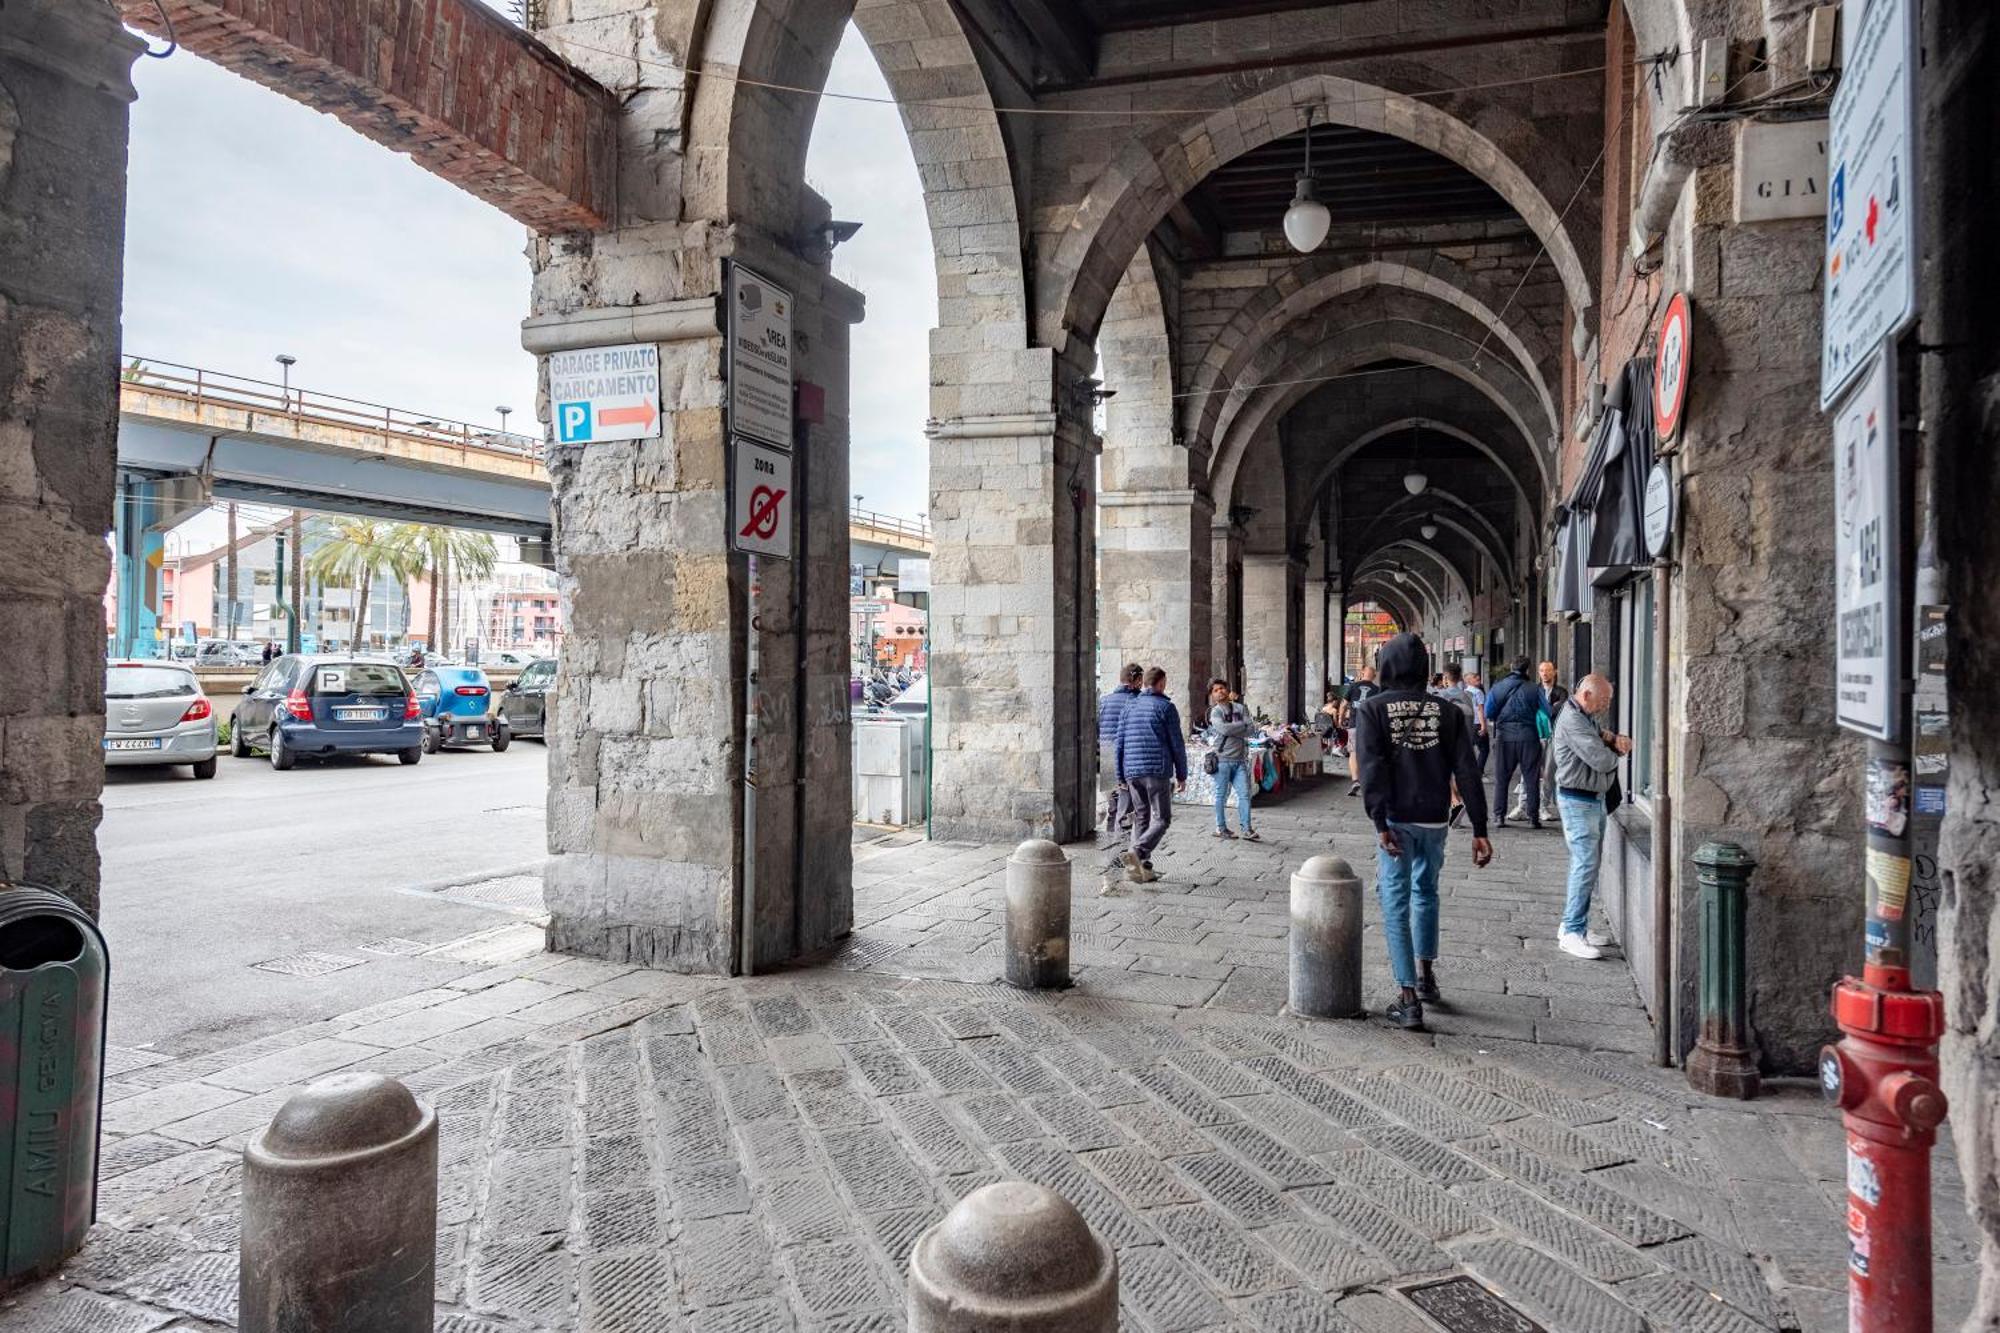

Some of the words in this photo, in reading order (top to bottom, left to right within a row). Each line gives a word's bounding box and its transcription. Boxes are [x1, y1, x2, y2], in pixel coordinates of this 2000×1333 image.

[552, 354, 600, 375] GARAGE
[603, 348, 656, 371] PRIVATO
[553, 375, 656, 401] CARICAMENTO
[564, 406, 586, 439] P
[754, 457, 775, 475] zona
[323, 673, 340, 688] P
[25, 1110, 59, 1198] AMIU
